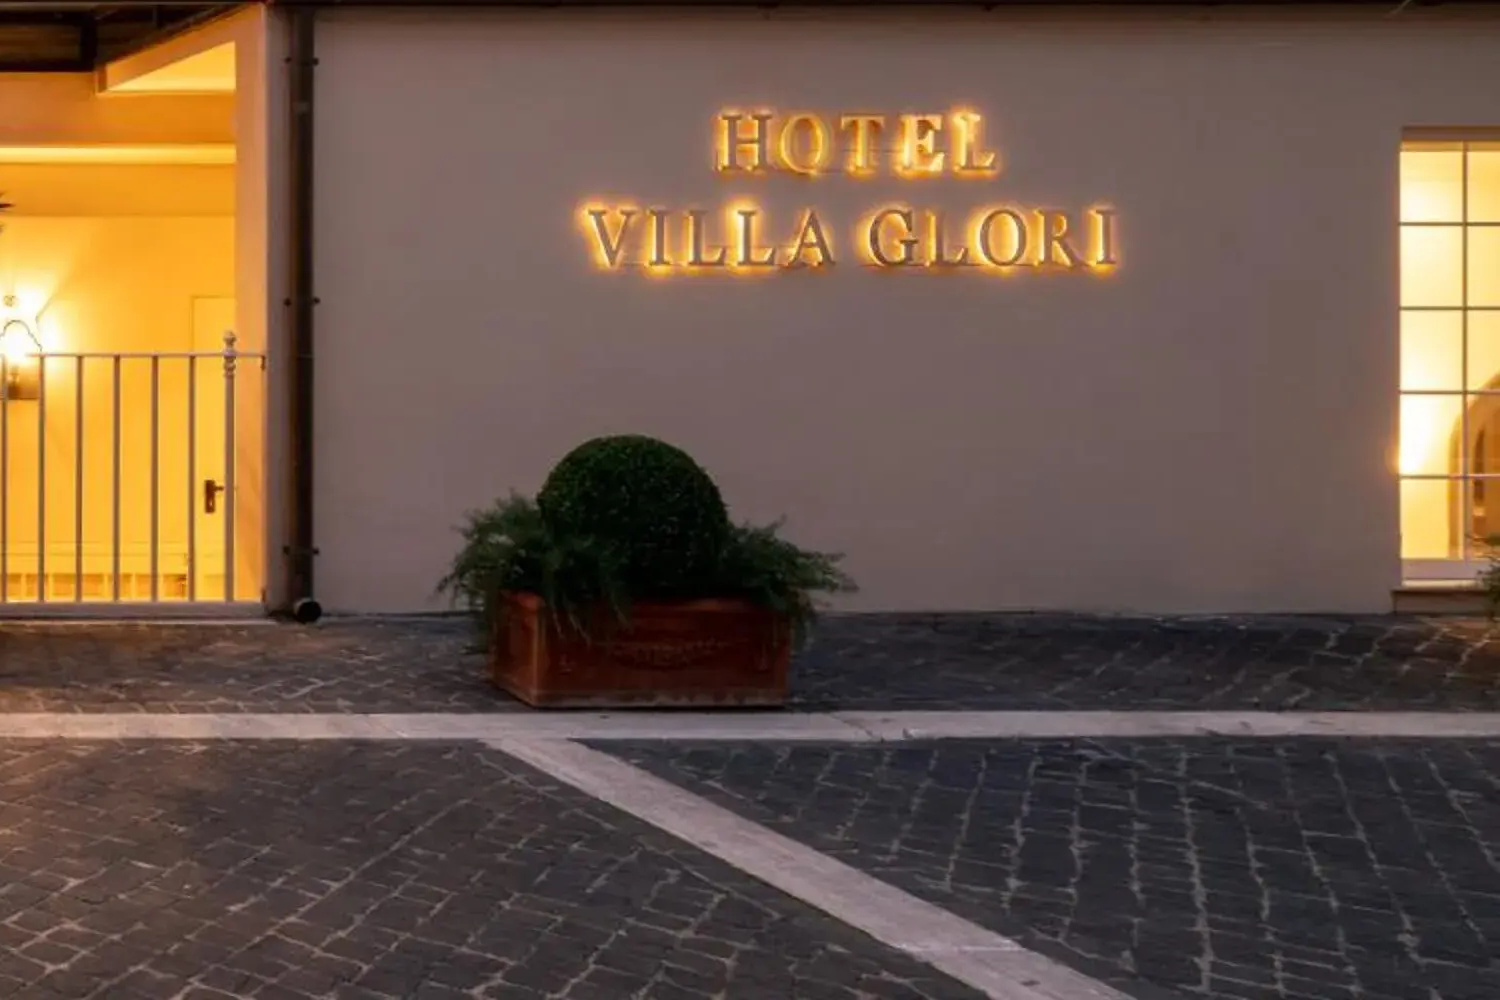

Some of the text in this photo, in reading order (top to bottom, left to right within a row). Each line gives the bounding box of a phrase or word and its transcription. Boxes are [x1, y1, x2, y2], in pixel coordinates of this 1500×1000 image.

[716, 111, 997, 175] HOTEL
[588, 208, 1119, 268] VILLA GLORI
